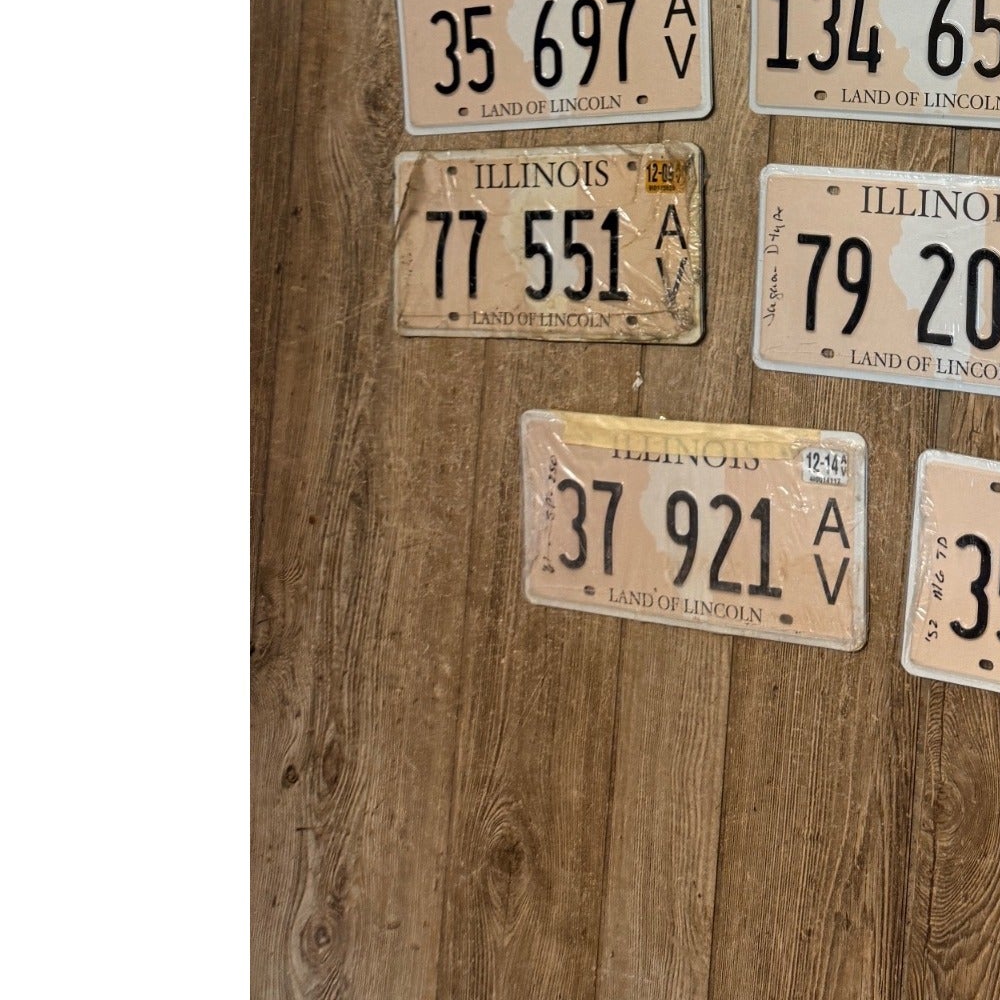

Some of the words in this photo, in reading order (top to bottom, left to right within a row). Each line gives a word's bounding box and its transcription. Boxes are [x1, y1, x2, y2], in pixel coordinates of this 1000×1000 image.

[430, 5, 495, 95] 35
[481, 103, 523, 118] LAND
[526, 101, 547, 114] OF
[550, 94, 622, 113] LINCOLN
[841, 88, 891, 105] LAND
[894, 90, 920, 107] OF
[474, 160, 610, 189] ILLINOIS
[426, 210, 487, 299] 77
[524, 208, 629, 301] 551
[798, 233, 872, 336] 79
[472, 311, 514, 326] LAND
[517, 312, 538, 326] OF
[539, 312, 611, 328] LINCOLN
[851, 349, 902, 368] LAND
[907, 355, 932, 371] OF
[612, 434, 760, 471] ILLINOIS
[806, 452, 838, 474] 12-14
[557, 478, 623, 575] 37
[666, 490, 782, 599] 921
[609, 587, 654, 607] LAND
[658, 594, 680, 611] OF
[683, 599, 763, 624] LINCOLN
[925, 619, 938, 642] '52
